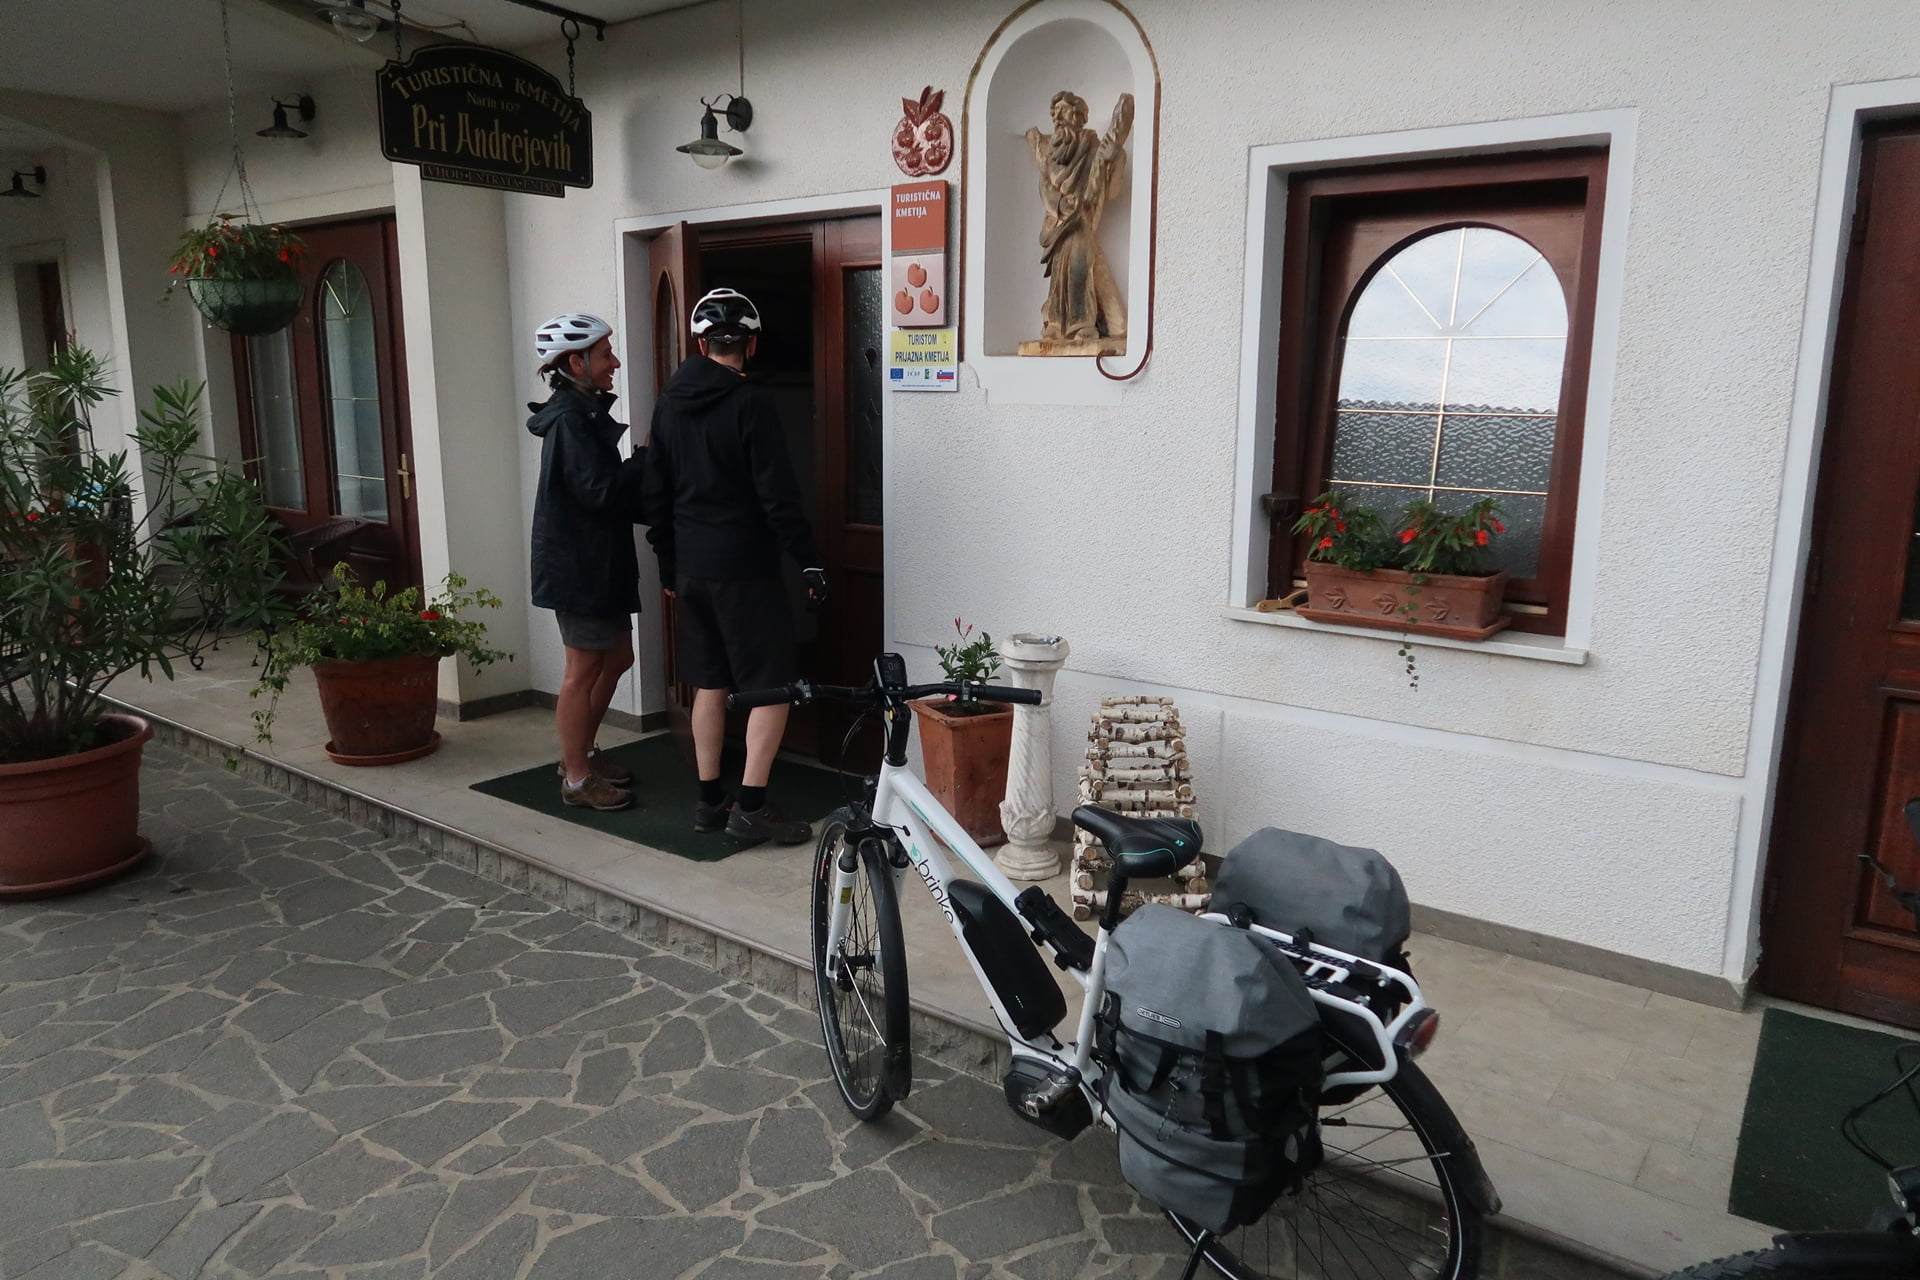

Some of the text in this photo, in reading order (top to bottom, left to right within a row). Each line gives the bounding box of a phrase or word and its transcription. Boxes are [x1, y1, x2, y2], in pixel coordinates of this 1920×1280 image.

[391, 63, 581, 132] TURISTIČNA KMETIJA
[412, 103, 573, 175] Pri Andrejevih
[895, 189, 941, 204] TURISTIČNA
[895, 206, 927, 218] KMETIJA
[908, 333, 937, 345] TURISTOM
[895, 350, 950, 363] PRIJAZNA KMETIJA
